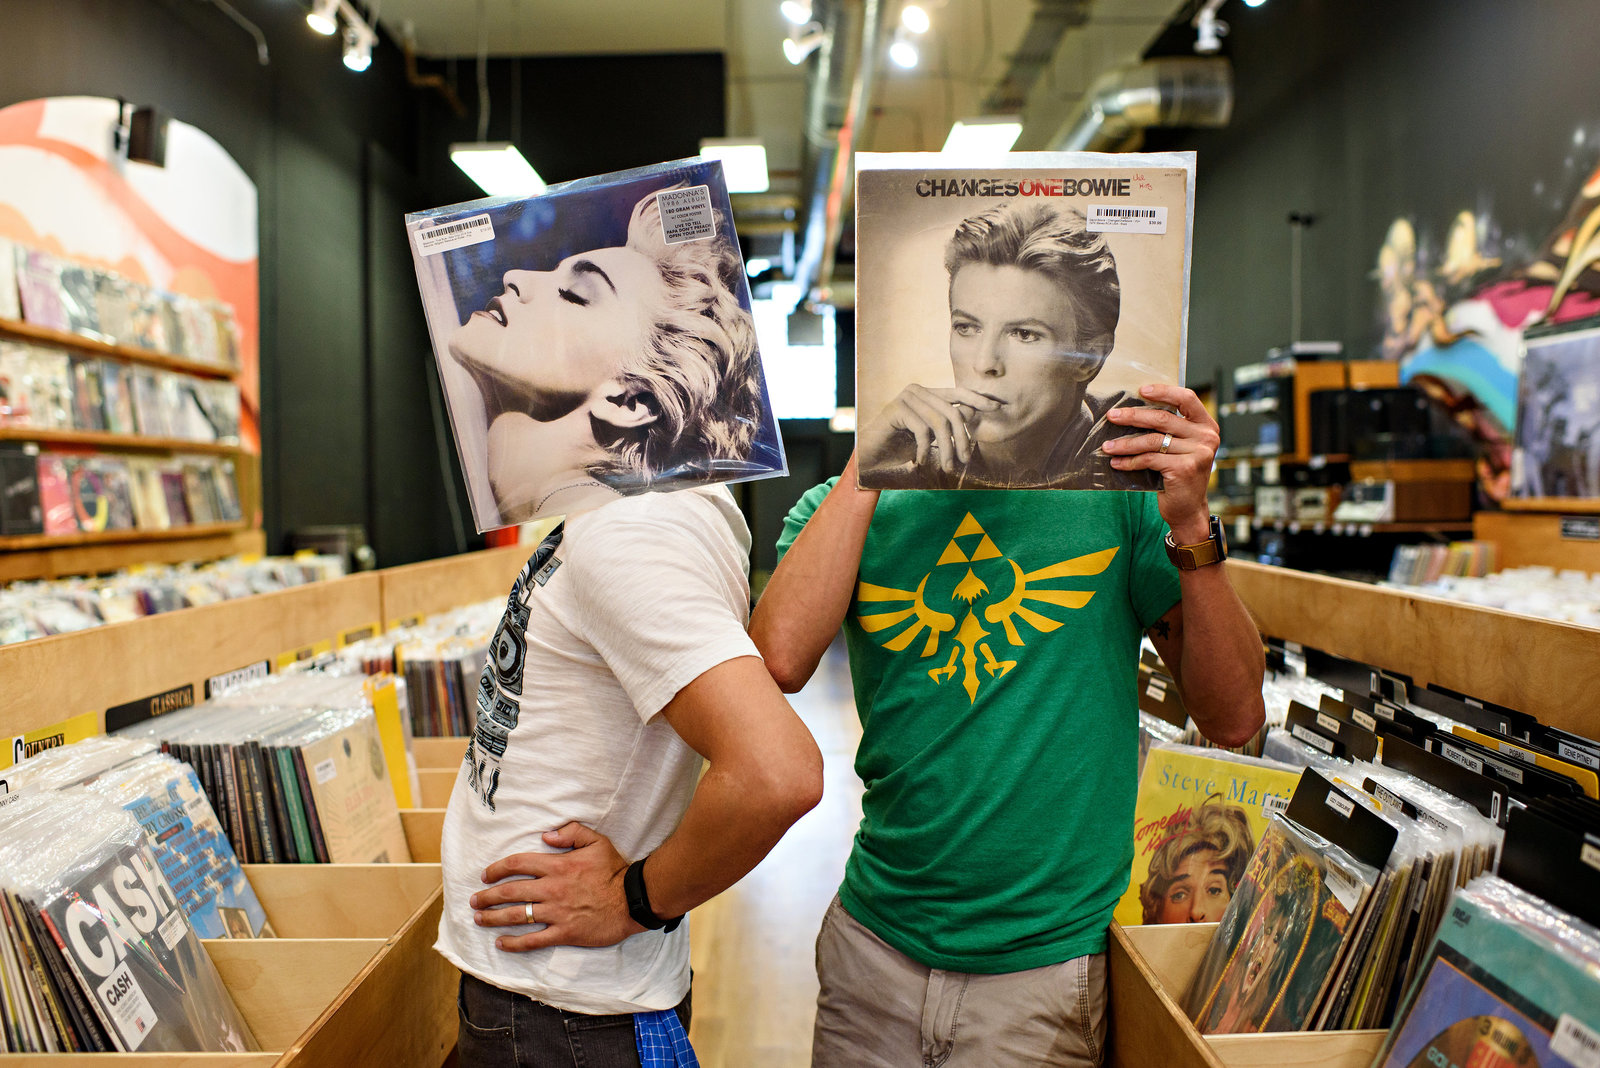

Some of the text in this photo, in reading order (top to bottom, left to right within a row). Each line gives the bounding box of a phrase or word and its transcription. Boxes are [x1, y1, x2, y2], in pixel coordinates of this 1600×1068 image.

[661, 189, 705, 201] MADONNA'S
[915, 178, 1131, 197] CHANGESONEBOWIE
[151, 686, 194, 716] CLASSICAL
[1446, 745, 1478, 771] ROBERT PALMER
[1508, 749, 1525, 760] PIGBAG
[1563, 747, 1593, 766] GENE PITNEY
[1158, 764, 1292, 807] Steve Mar
[1376, 786, 1384, 799] THE
[65, 845, 178, 977] CASH
[1453, 906, 1472, 925] RCA
[105, 971, 133, 1007] CASH
